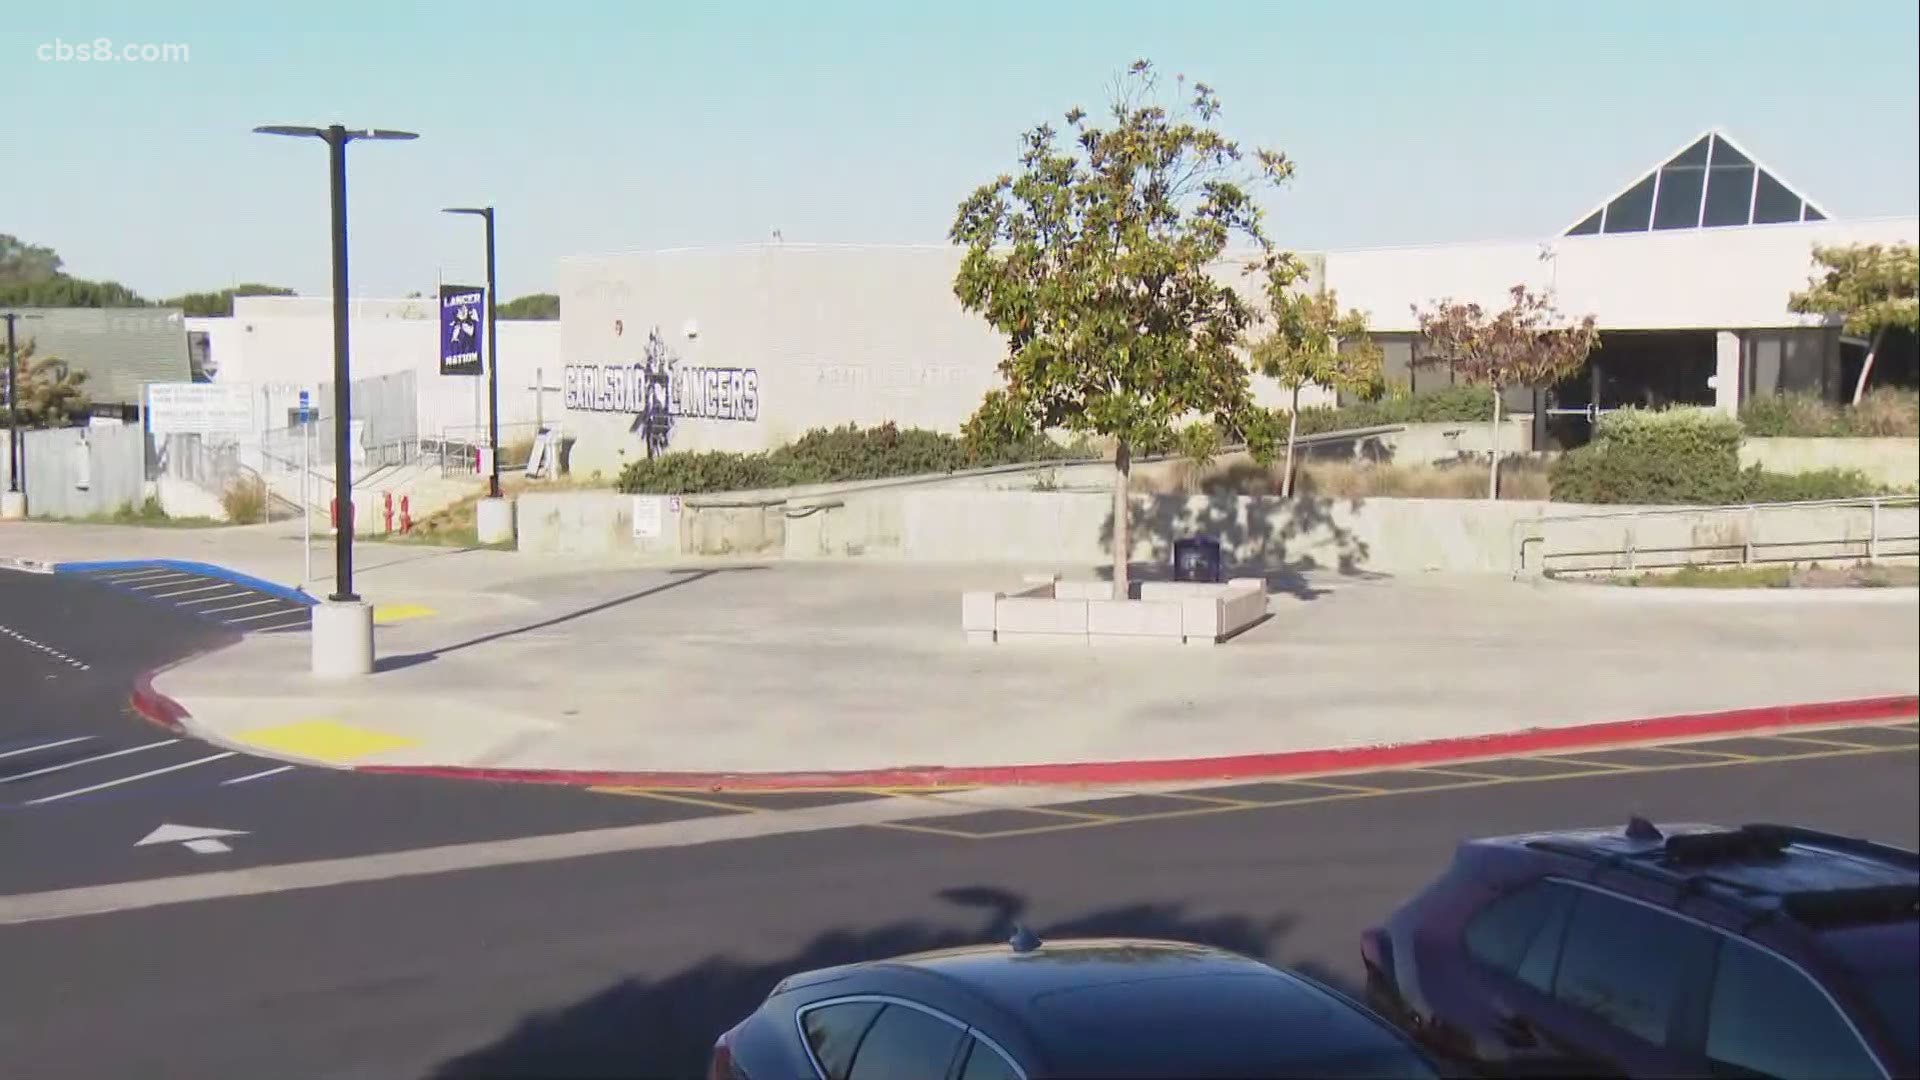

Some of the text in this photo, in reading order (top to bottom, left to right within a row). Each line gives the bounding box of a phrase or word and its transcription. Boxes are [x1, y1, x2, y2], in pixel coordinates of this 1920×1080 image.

[443, 292, 481, 308] LANCER
[445, 351, 478, 366] NATION
[565, 364, 646, 413] CARLSBAD
[667, 366, 760, 422] LANCERS
